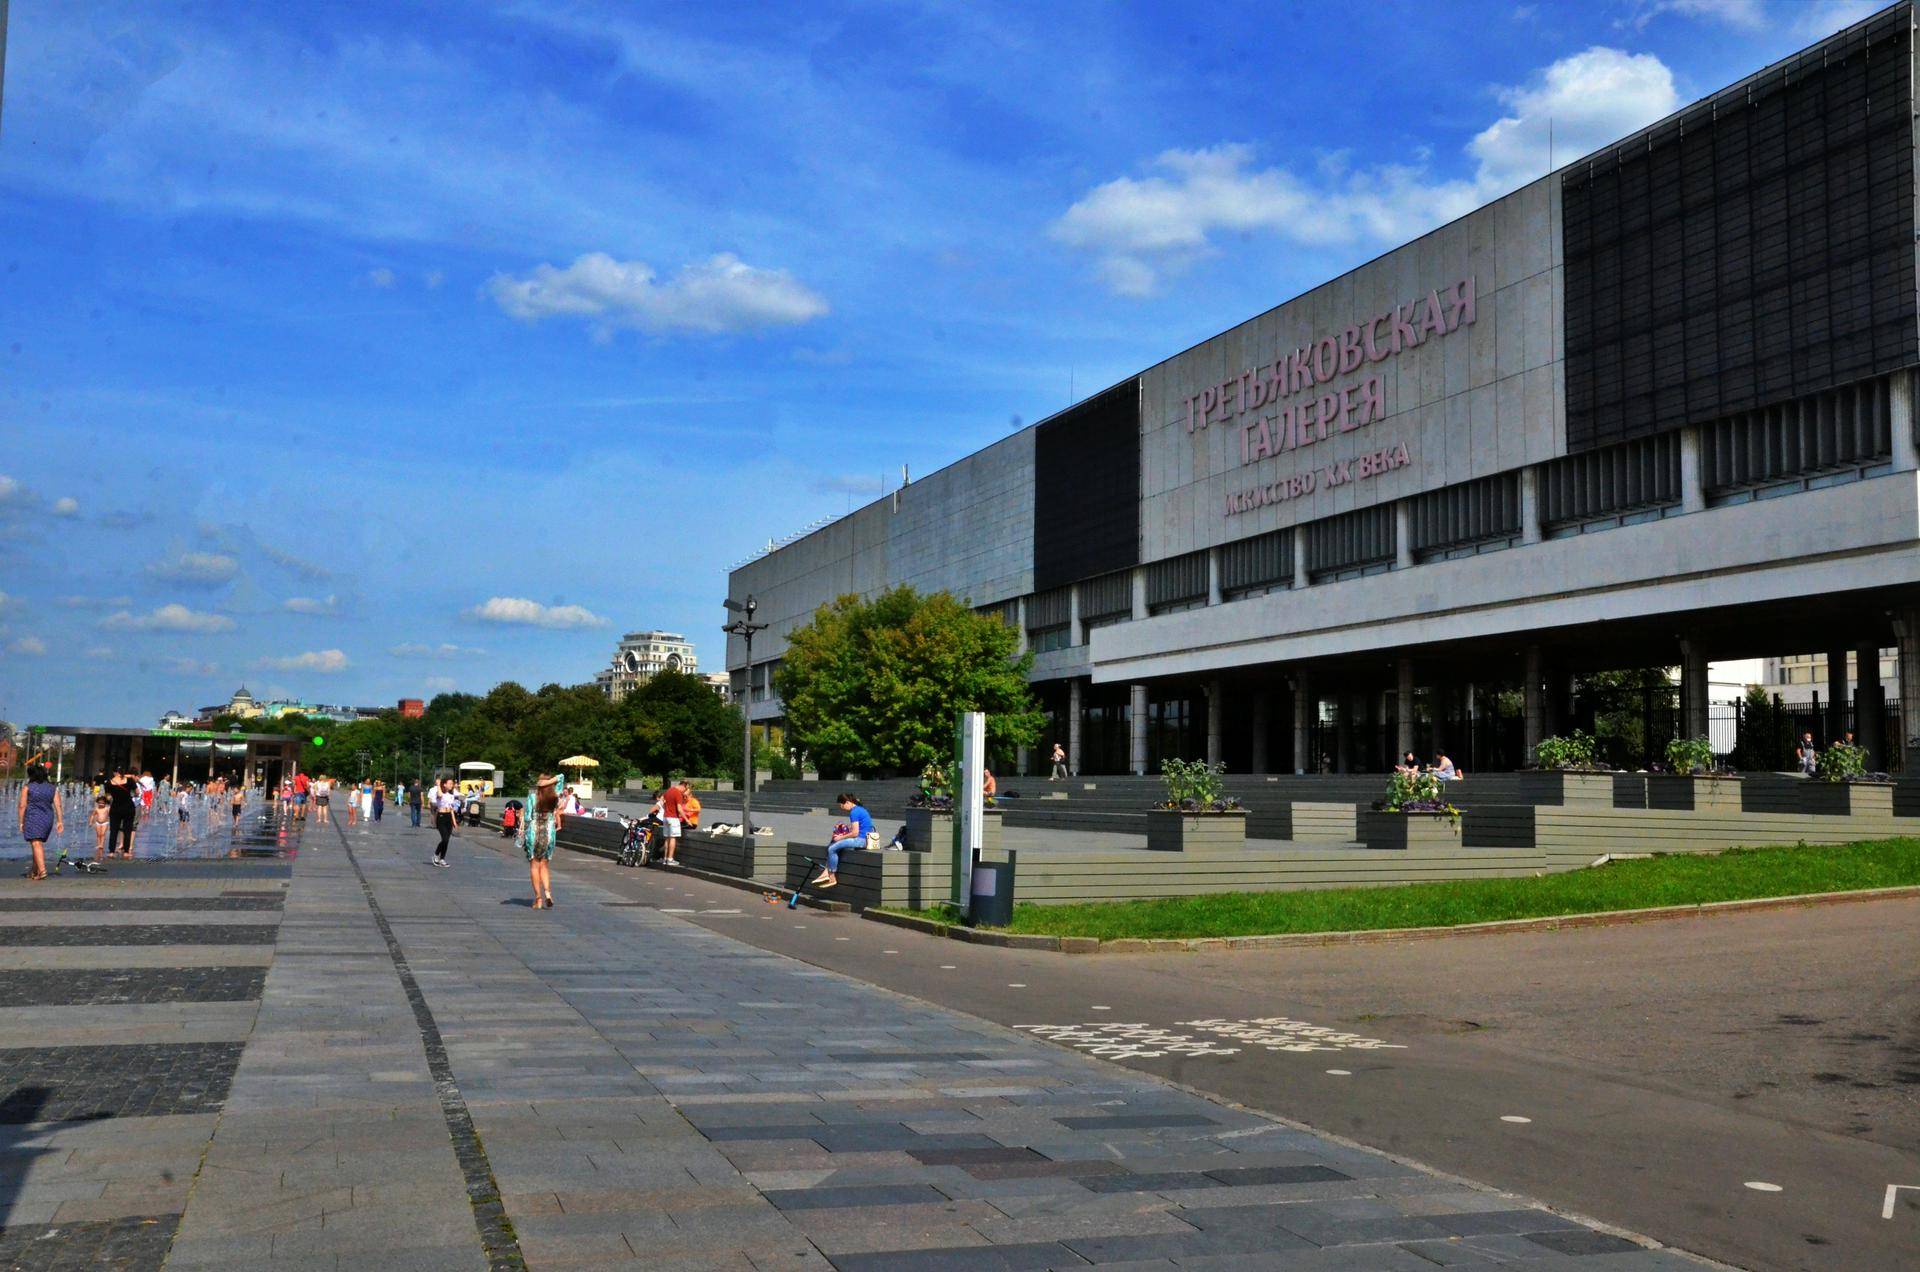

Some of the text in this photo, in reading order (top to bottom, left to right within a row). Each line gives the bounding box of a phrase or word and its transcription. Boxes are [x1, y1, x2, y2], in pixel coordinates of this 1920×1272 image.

[1184, 275, 1477, 433] ТРЕТЬЯКОВСКАЯ
[1240, 374, 1387, 465] ГАЛЕРЕЯ
[1224, 472, 1317, 517] ИСКУССТВО
[1359, 441, 1411, 479] ВЕКА
